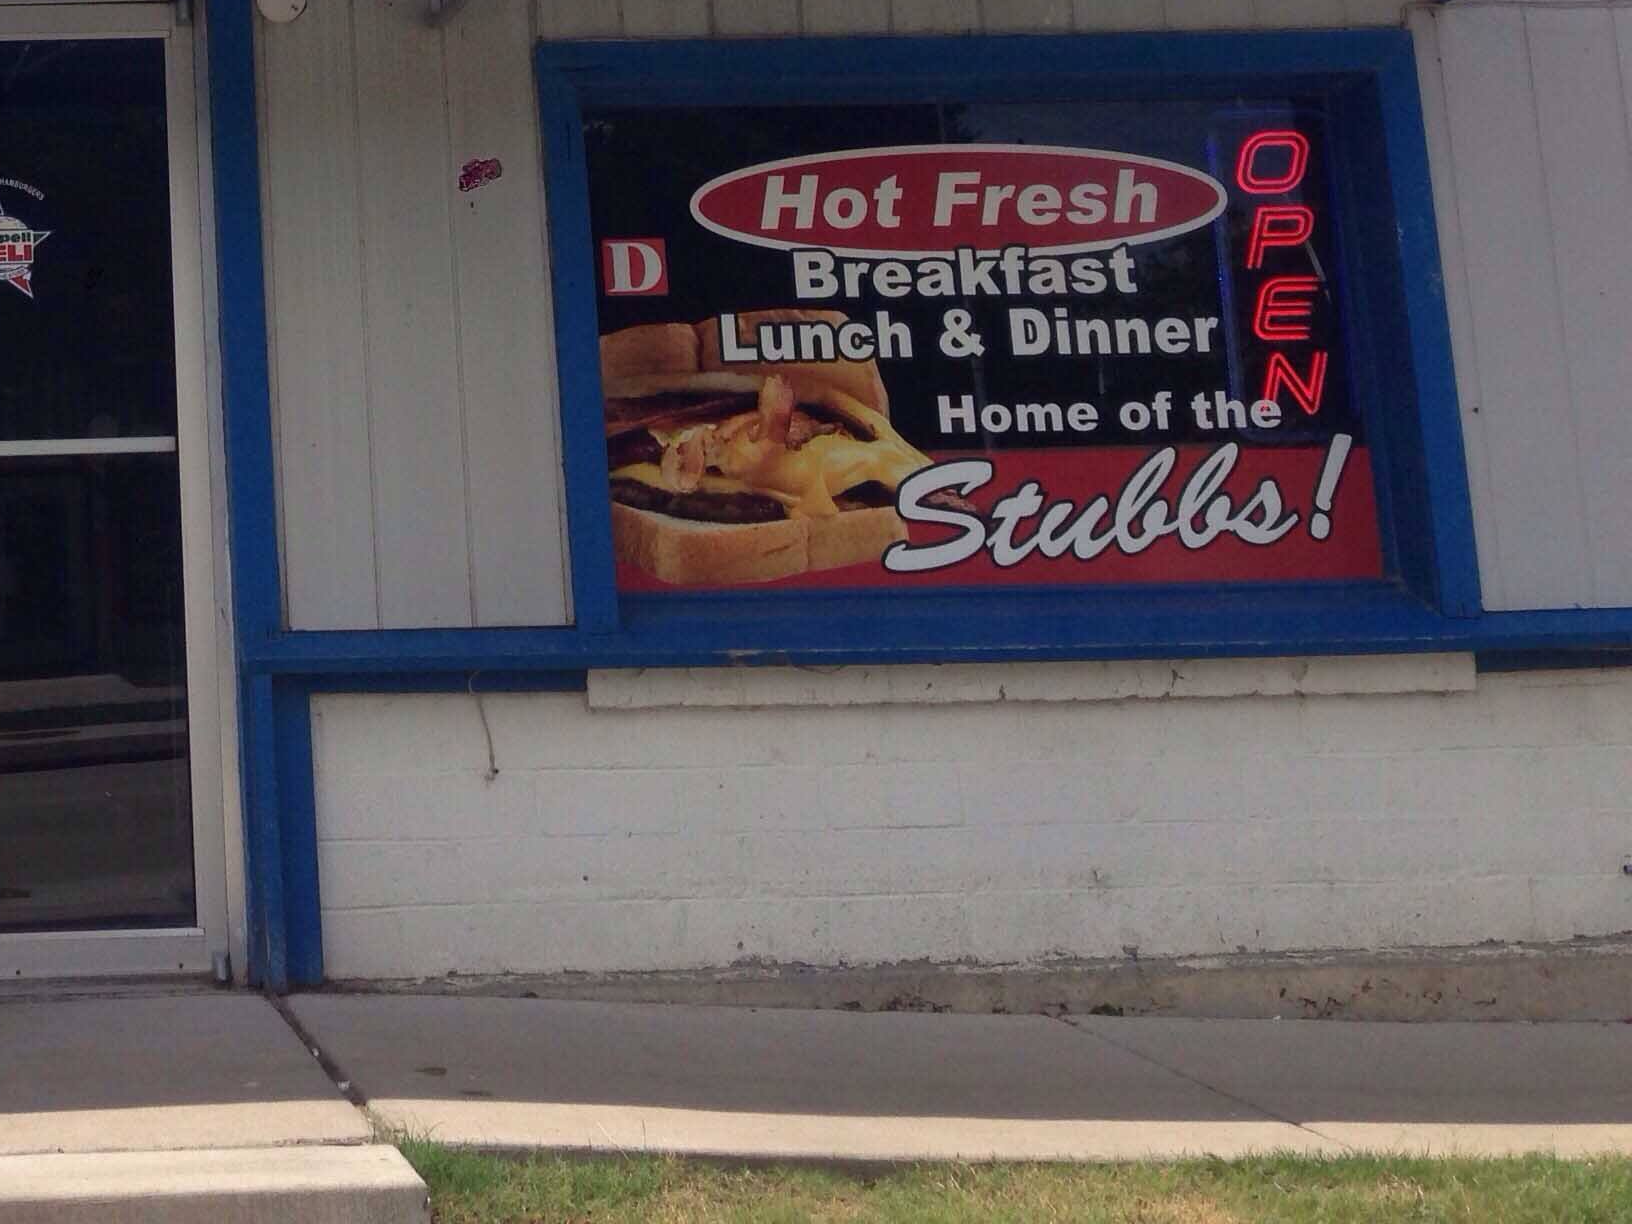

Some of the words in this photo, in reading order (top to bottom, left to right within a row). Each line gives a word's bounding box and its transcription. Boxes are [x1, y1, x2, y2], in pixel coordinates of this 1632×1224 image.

[761, 174, 902, 230] Hot
[932, 170, 1159, 228] Fresh
[607, 243, 663, 292] D
[791, 242, 1138, 300] Breakfast
[1235, 129, 1328, 416] OPEN
[719, 308, 914, 362] Lunch
[939, 311, 986, 358] &
[1010, 306, 1219, 356] Dinner
[937, 393, 1099, 434] Home
[1119, 391, 1172, 432] of
[1191, 390, 1283, 430] the
[883, 432, 1354, 574] Stubbs!
